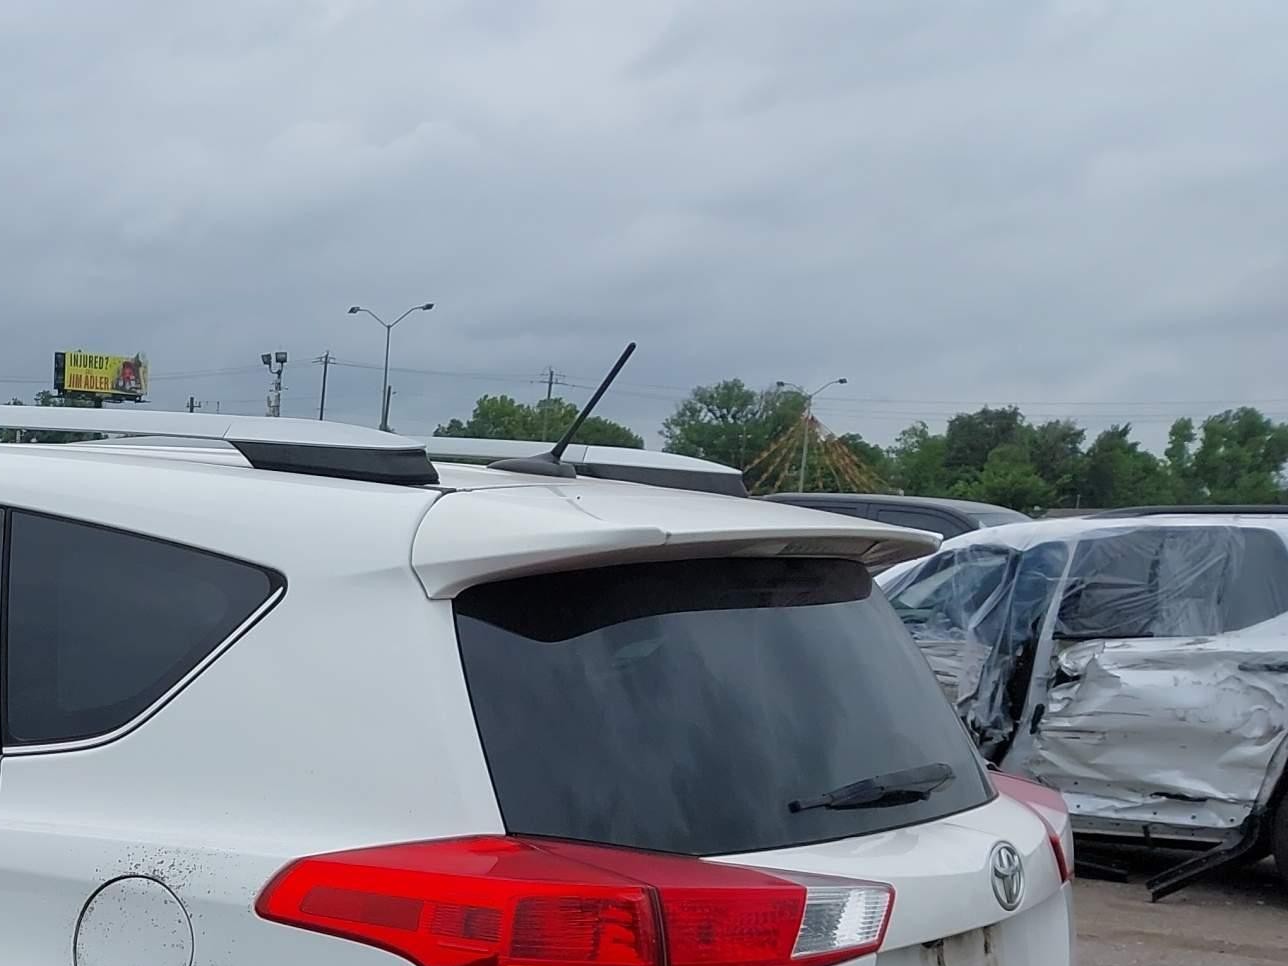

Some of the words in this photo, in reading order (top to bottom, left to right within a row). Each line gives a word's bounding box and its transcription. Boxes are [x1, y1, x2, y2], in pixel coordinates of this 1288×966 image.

[69, 352, 109, 370] INJURED?
[68, 373, 82, 388] JIM
[84, 375, 109, 390] ADLER
